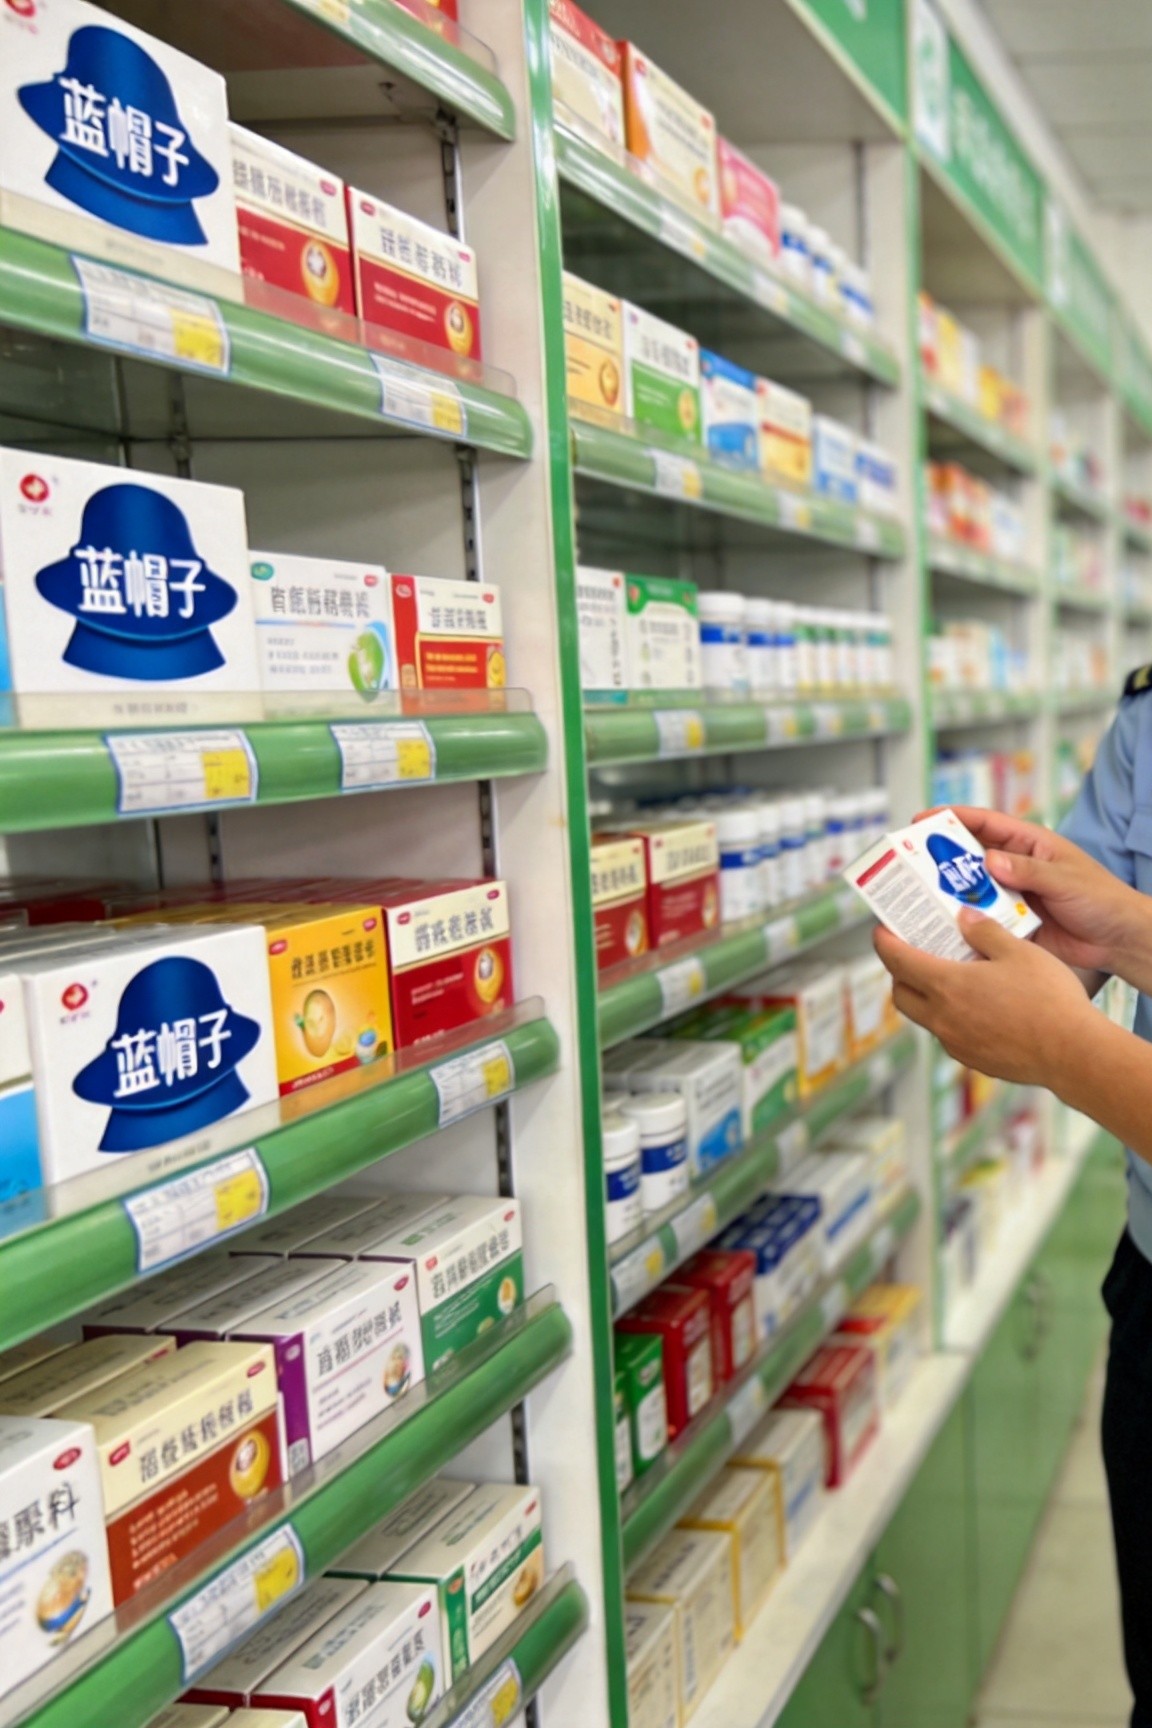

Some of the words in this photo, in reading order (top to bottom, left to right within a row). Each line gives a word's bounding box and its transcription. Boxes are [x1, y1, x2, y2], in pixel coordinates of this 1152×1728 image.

[58, 77, 190, 186] 蓝帽子
[74, 545, 206, 618] 蓝帽子
[111, 1009, 232, 1098] 蓝帽子
